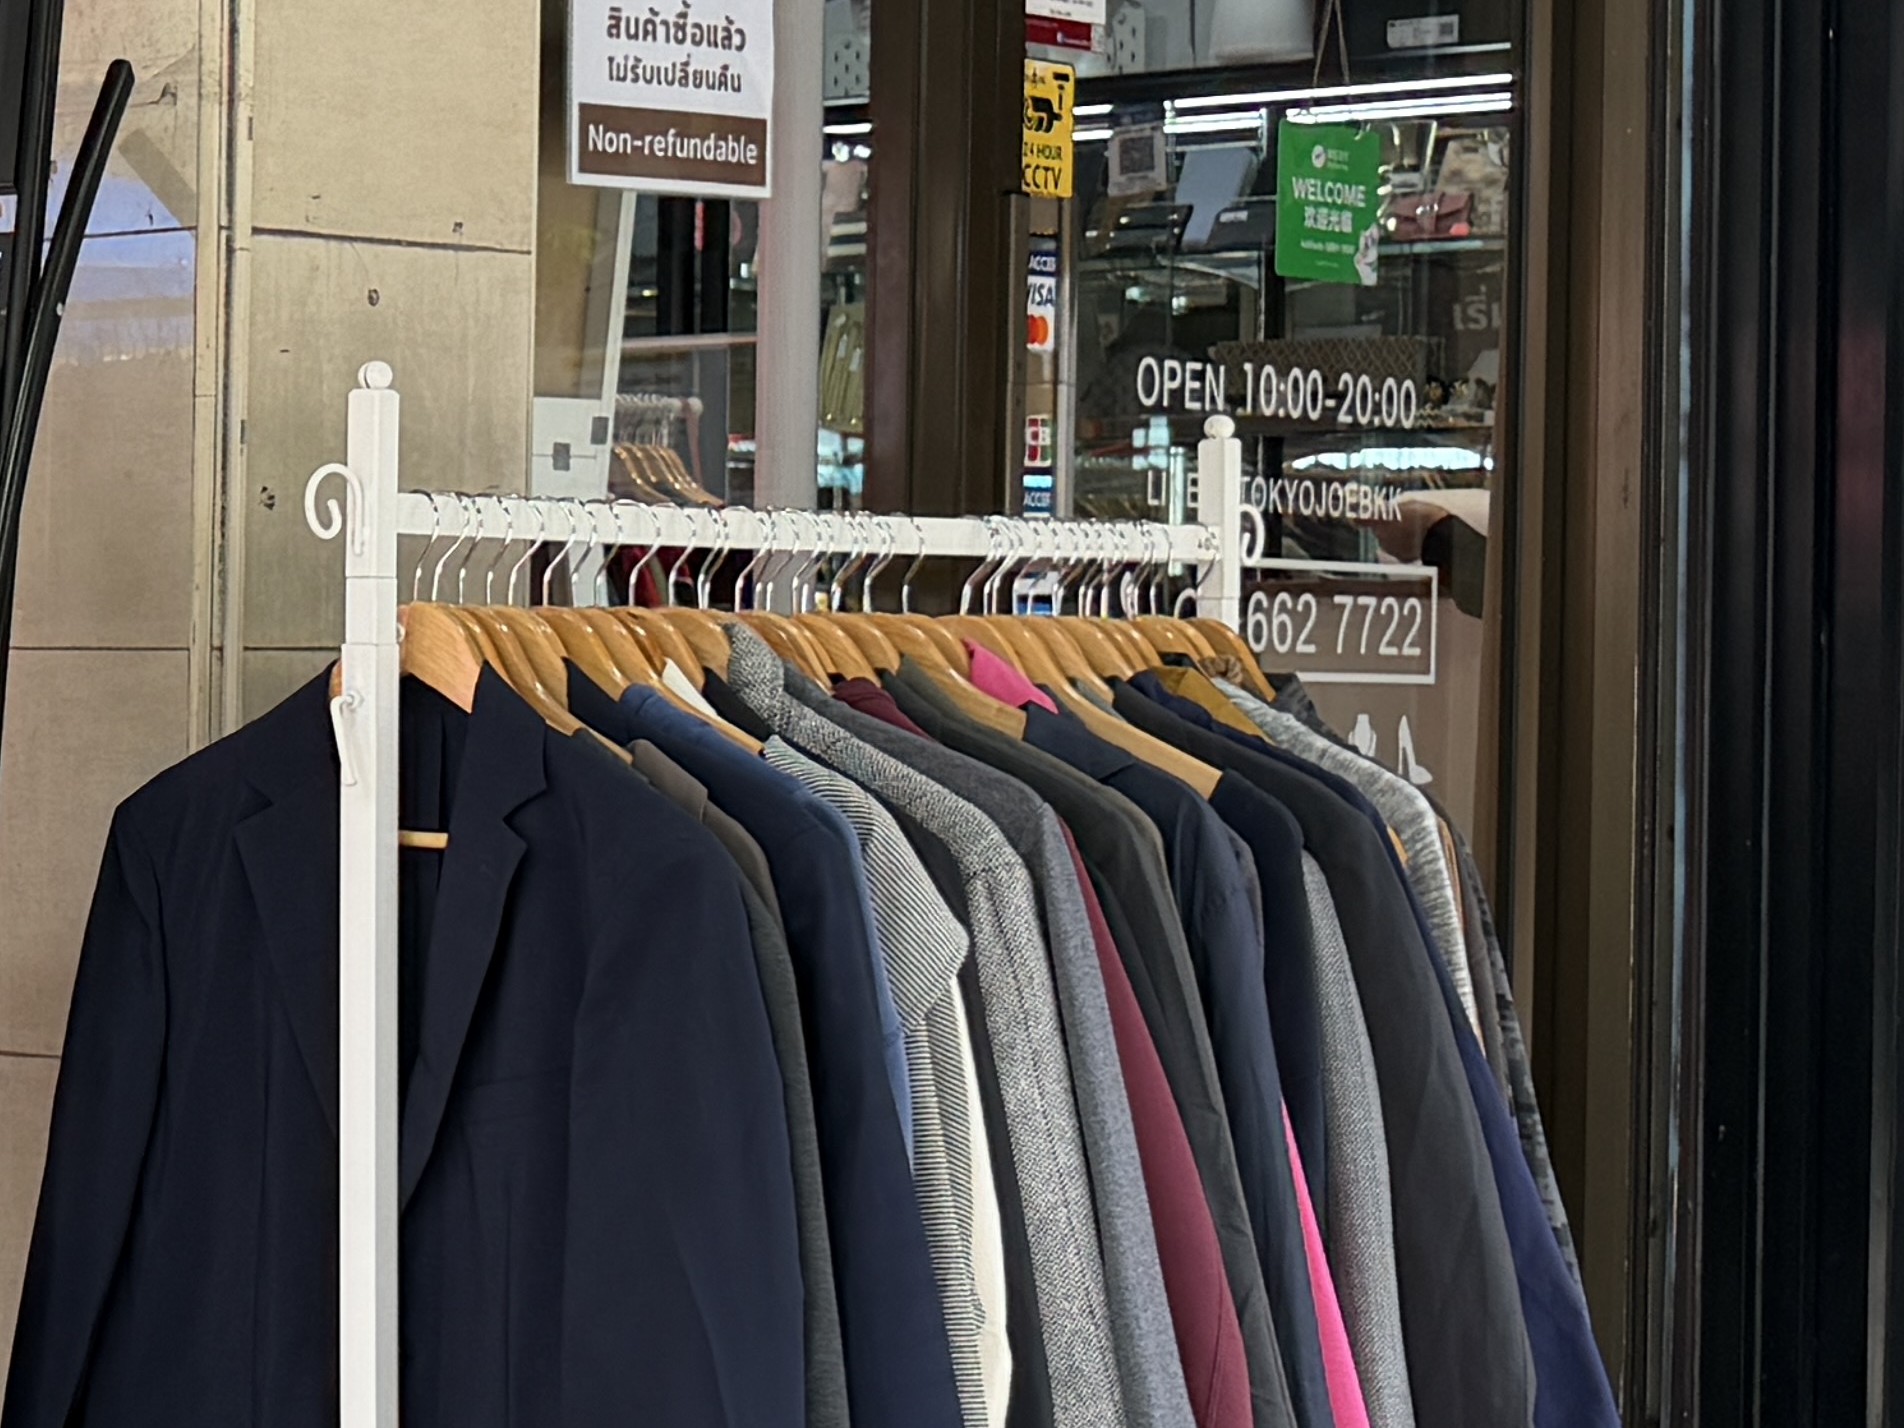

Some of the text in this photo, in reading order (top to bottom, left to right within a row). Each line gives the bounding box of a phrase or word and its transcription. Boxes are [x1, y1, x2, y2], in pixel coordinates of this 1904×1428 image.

[606, 0, 747, 53] สินค้าซื้อแล้ว
[587, 123, 758, 165] Non-refundable
[1022, 163, 1063, 190] CCTV
[1291, 176, 1367, 208] WELCOME
[1136, 356, 1417, 430] OPEN 10:00-20:00
[1146, 469, 1200, 510] LIE
[1246, 590, 1318, 655] 662
[1332, 594, 1423, 656] 7722
